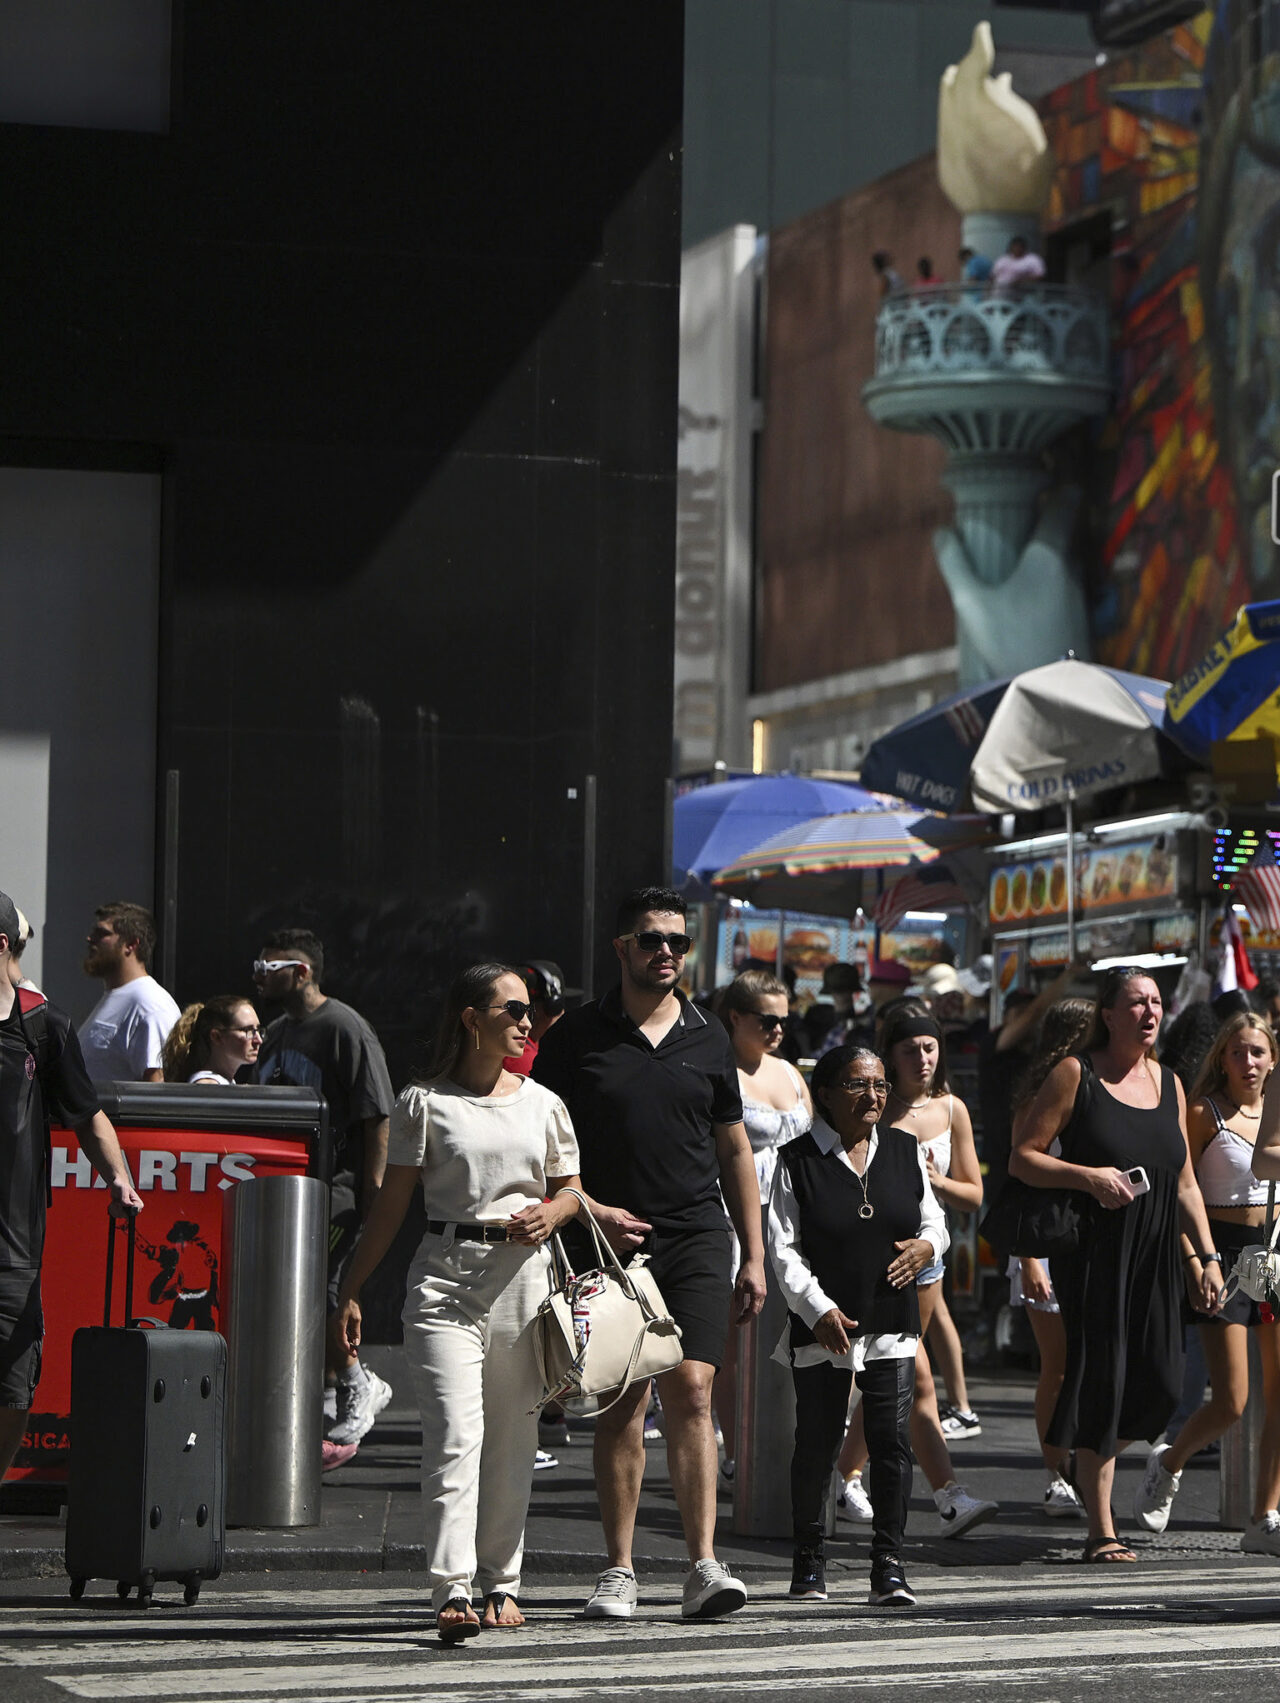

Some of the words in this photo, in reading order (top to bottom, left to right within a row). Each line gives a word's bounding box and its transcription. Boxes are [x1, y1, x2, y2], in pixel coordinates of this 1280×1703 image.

[896, 771, 921, 793] HOT
[921, 778, 956, 805] DOGS
[1007, 777, 1059, 801] COLD
[1061, 759, 1126, 792] DRINKS
